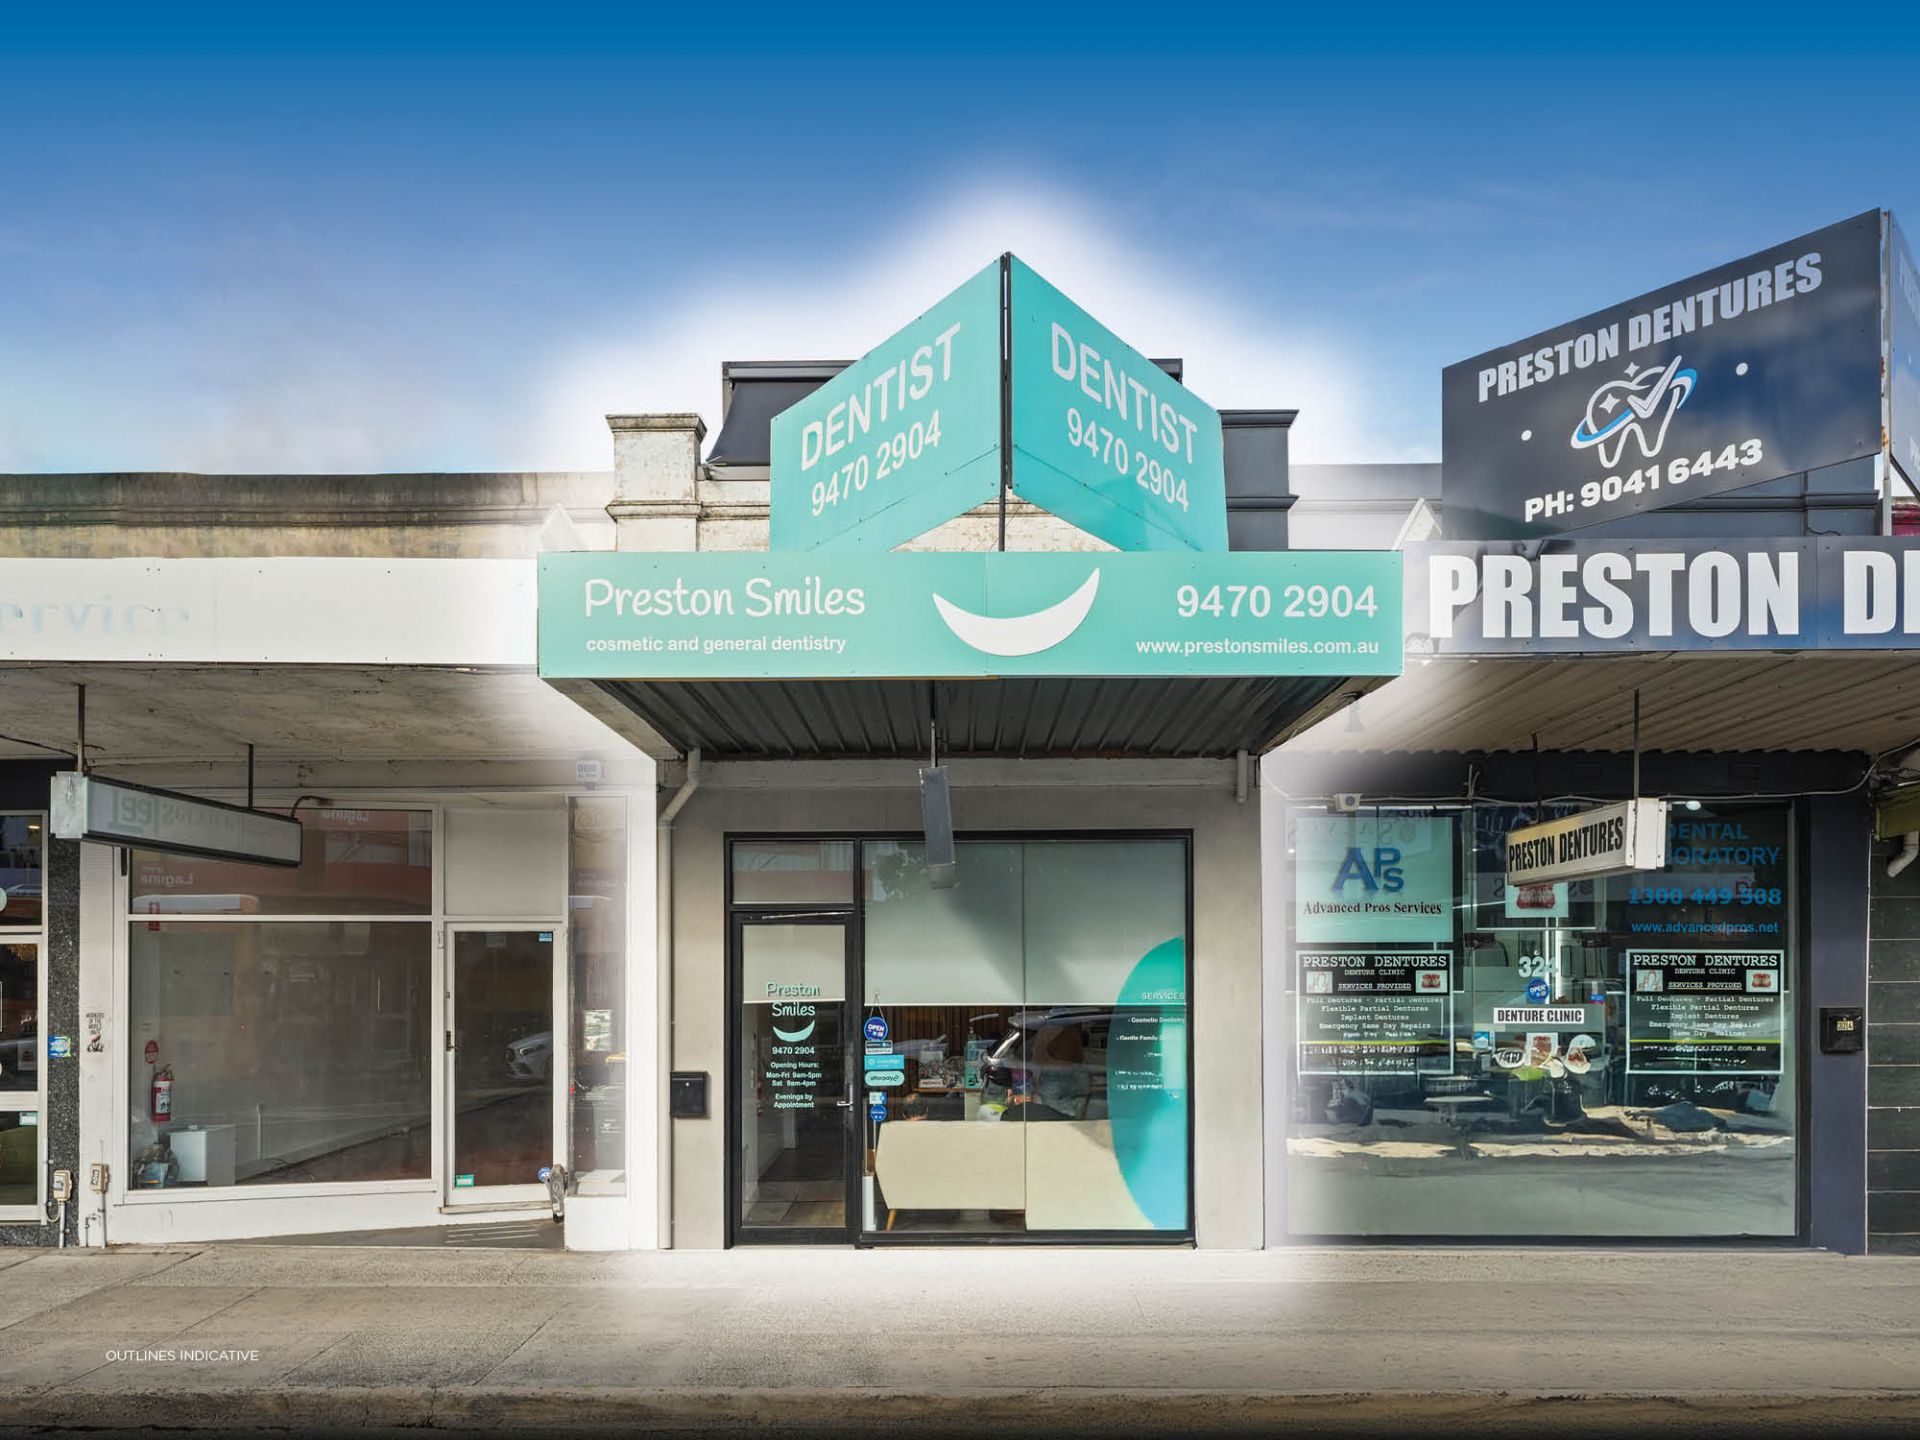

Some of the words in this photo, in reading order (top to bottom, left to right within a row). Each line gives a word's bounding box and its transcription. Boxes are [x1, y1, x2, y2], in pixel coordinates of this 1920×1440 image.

[1478, 323, 1619, 402] PRESTON
[1628, 252, 1823, 350] DENTURES
[801, 322, 961, 471] DENTIST
[1051, 322, 1198, 465] DENTIST
[812, 454, 869, 516] 9470
[876, 410, 942, 480] 2904
[1067, 408, 1129, 474] 9470
[1135, 451, 1189, 512] 2904
[1524, 490, 1574, 522] PH:
[1580, 469, 1660, 508] 9041
[1668, 438, 1763, 484] 6443
[585, 578, 734, 617] Preston
[745, 576, 866, 617] Smiles
[1176, 585, 1271, 618] 9470
[1284, 585, 1378, 618] 2904
[1429, 550, 1800, 639] PRESTON
[586, 637, 663, 652] cosmetic
[668, 636, 699, 651] and
[704, 636, 766, 654] general
[771, 635, 846, 653] dentistry
[1136, 638, 1379, 656] www.prestonsmiles.com.au
[1509, 835, 1555, 872] PRESTON
[1560, 816, 1623, 863] DENTURES
[1628, 887, 1684, 905] 1300
[1690, 887, 1733, 905] 449
[1303, 902, 1361, 915] Advanced
[1365, 903, 1391, 913] Pros
[1394, 902, 1442, 915] Services
[1631, 921, 1779, 935] www.advancedpros.net
[1303, 956, 1366, 967] PRESTON
[1375, 956, 1447, 967] DENTURES
[1633, 955, 1696, 966] PRESTON
[1705, 955, 1777, 966] DENTURES
[767, 981, 821, 997] Preston
[1141, 992, 1185, 1000] SERVICES
[1529, 984, 1547, 993] OPEN
[772, 1001, 815, 1016] Smiles
[1497, 1010, 1544, 1022] DENTURE
[1547, 1010, 1582, 1022] CLINIC
[1341, 1014, 1371, 1022] Implant
[867, 1023, 885, 1032] OPEN
[772, 1047, 793, 1055] 9470
[795, 1047, 815, 1055] 2904
[770, 1061, 797, 1069] Opening
[792, 1072, 822, 1080] 9am-5pm
[786, 1080, 817, 1088] 9am-4pm
[775, 1093, 804, 1101] Evenings
[805, 1093, 813, 1101] by
